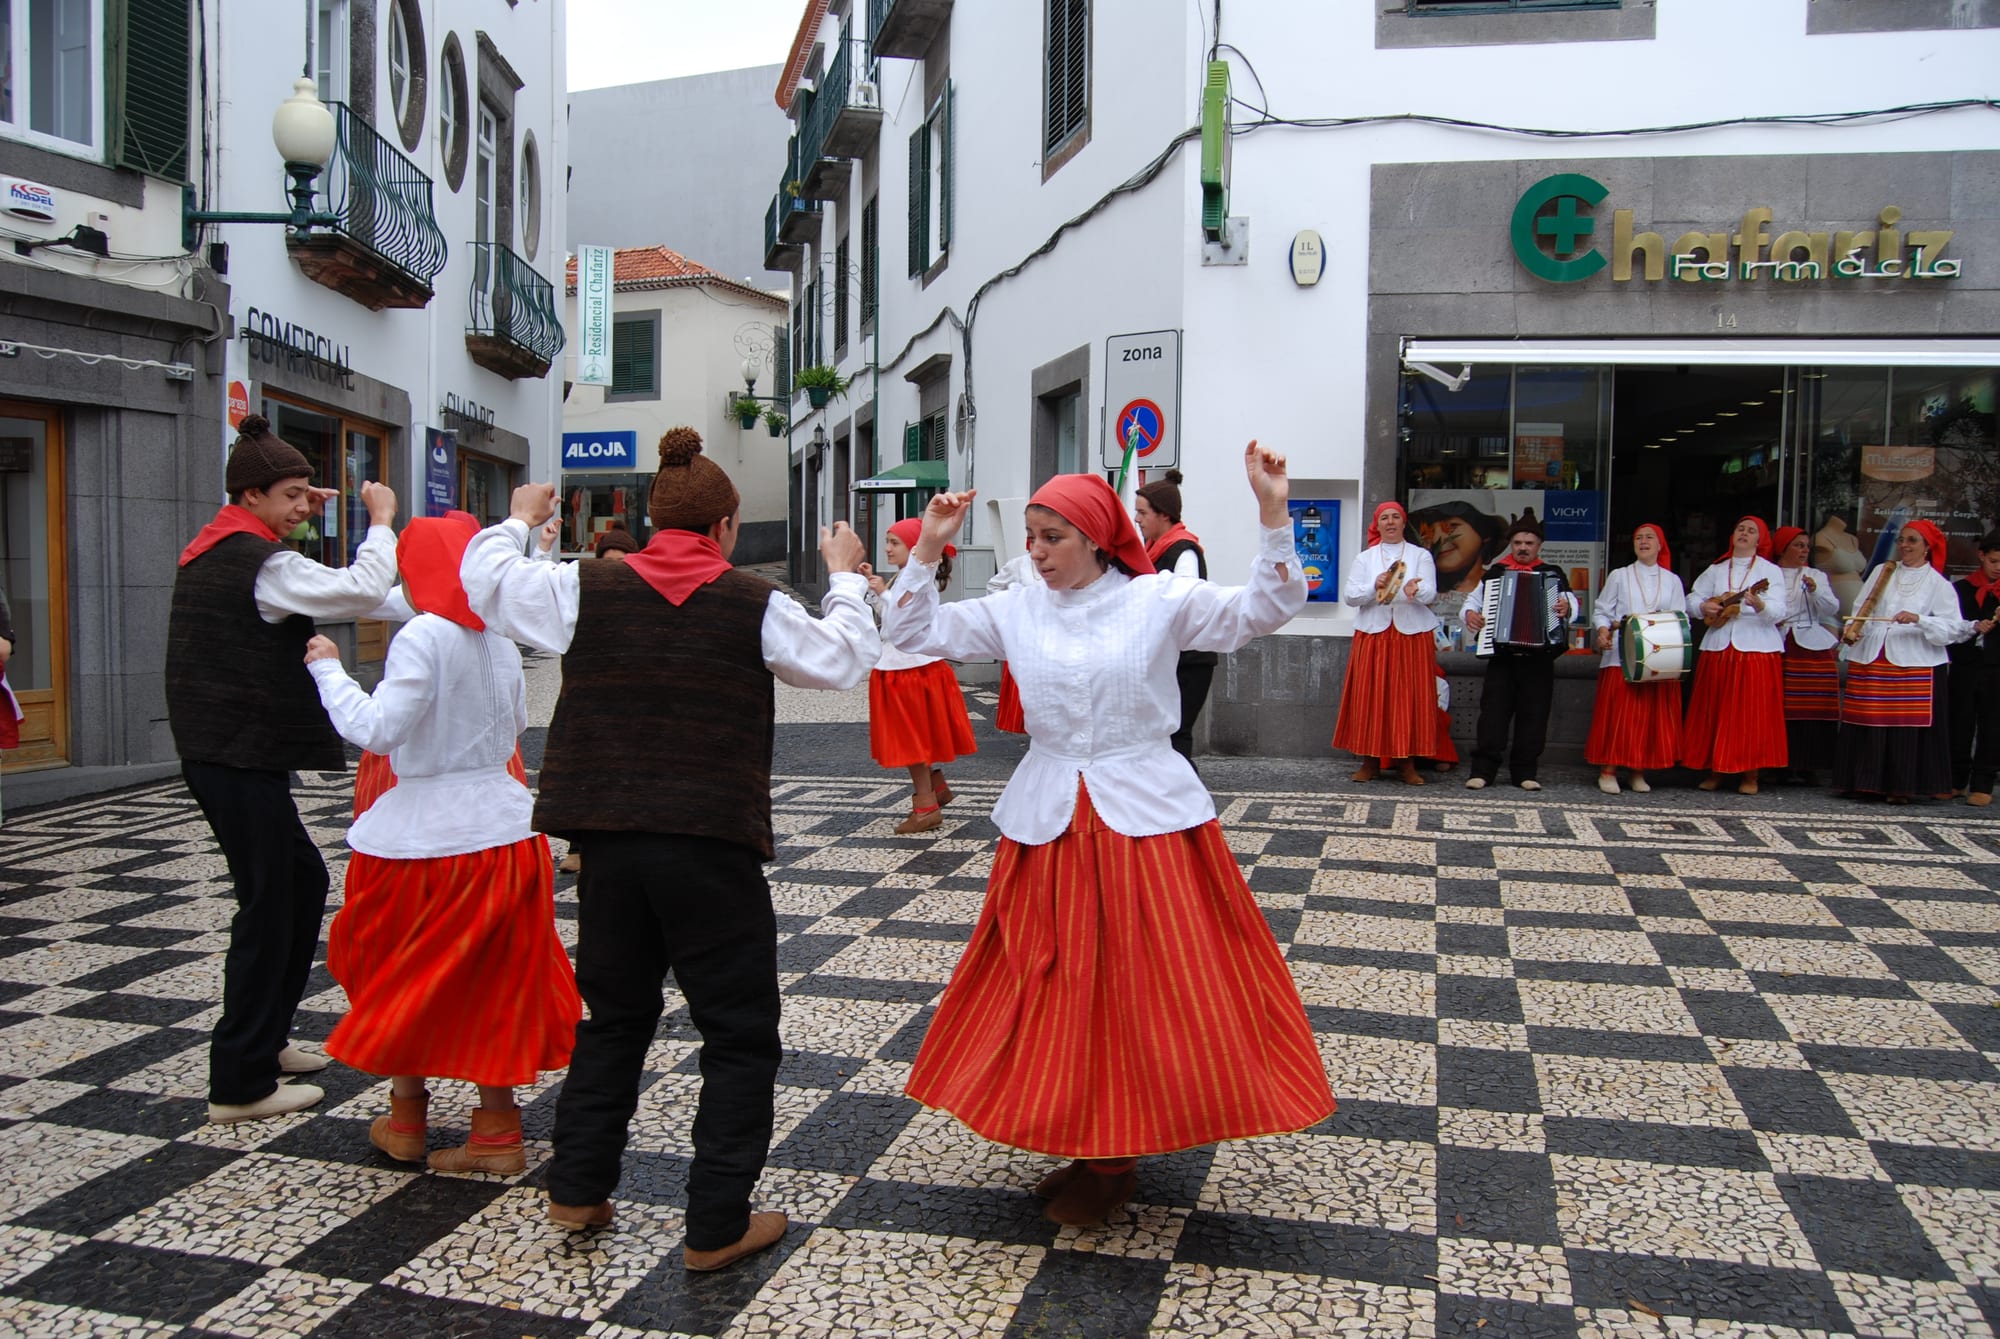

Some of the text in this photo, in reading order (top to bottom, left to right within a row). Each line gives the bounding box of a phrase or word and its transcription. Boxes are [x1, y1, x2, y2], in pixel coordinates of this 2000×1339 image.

[589, 249, 603, 356] Residencial Chafariz
[1716, 313, 1738, 328] 14
[248, 306, 354, 392] COMERCIAL
[1122, 346, 1162, 362] zona
[565, 441, 627, 458] ALOJA
[1551, 507, 1588, 517] VICHY
